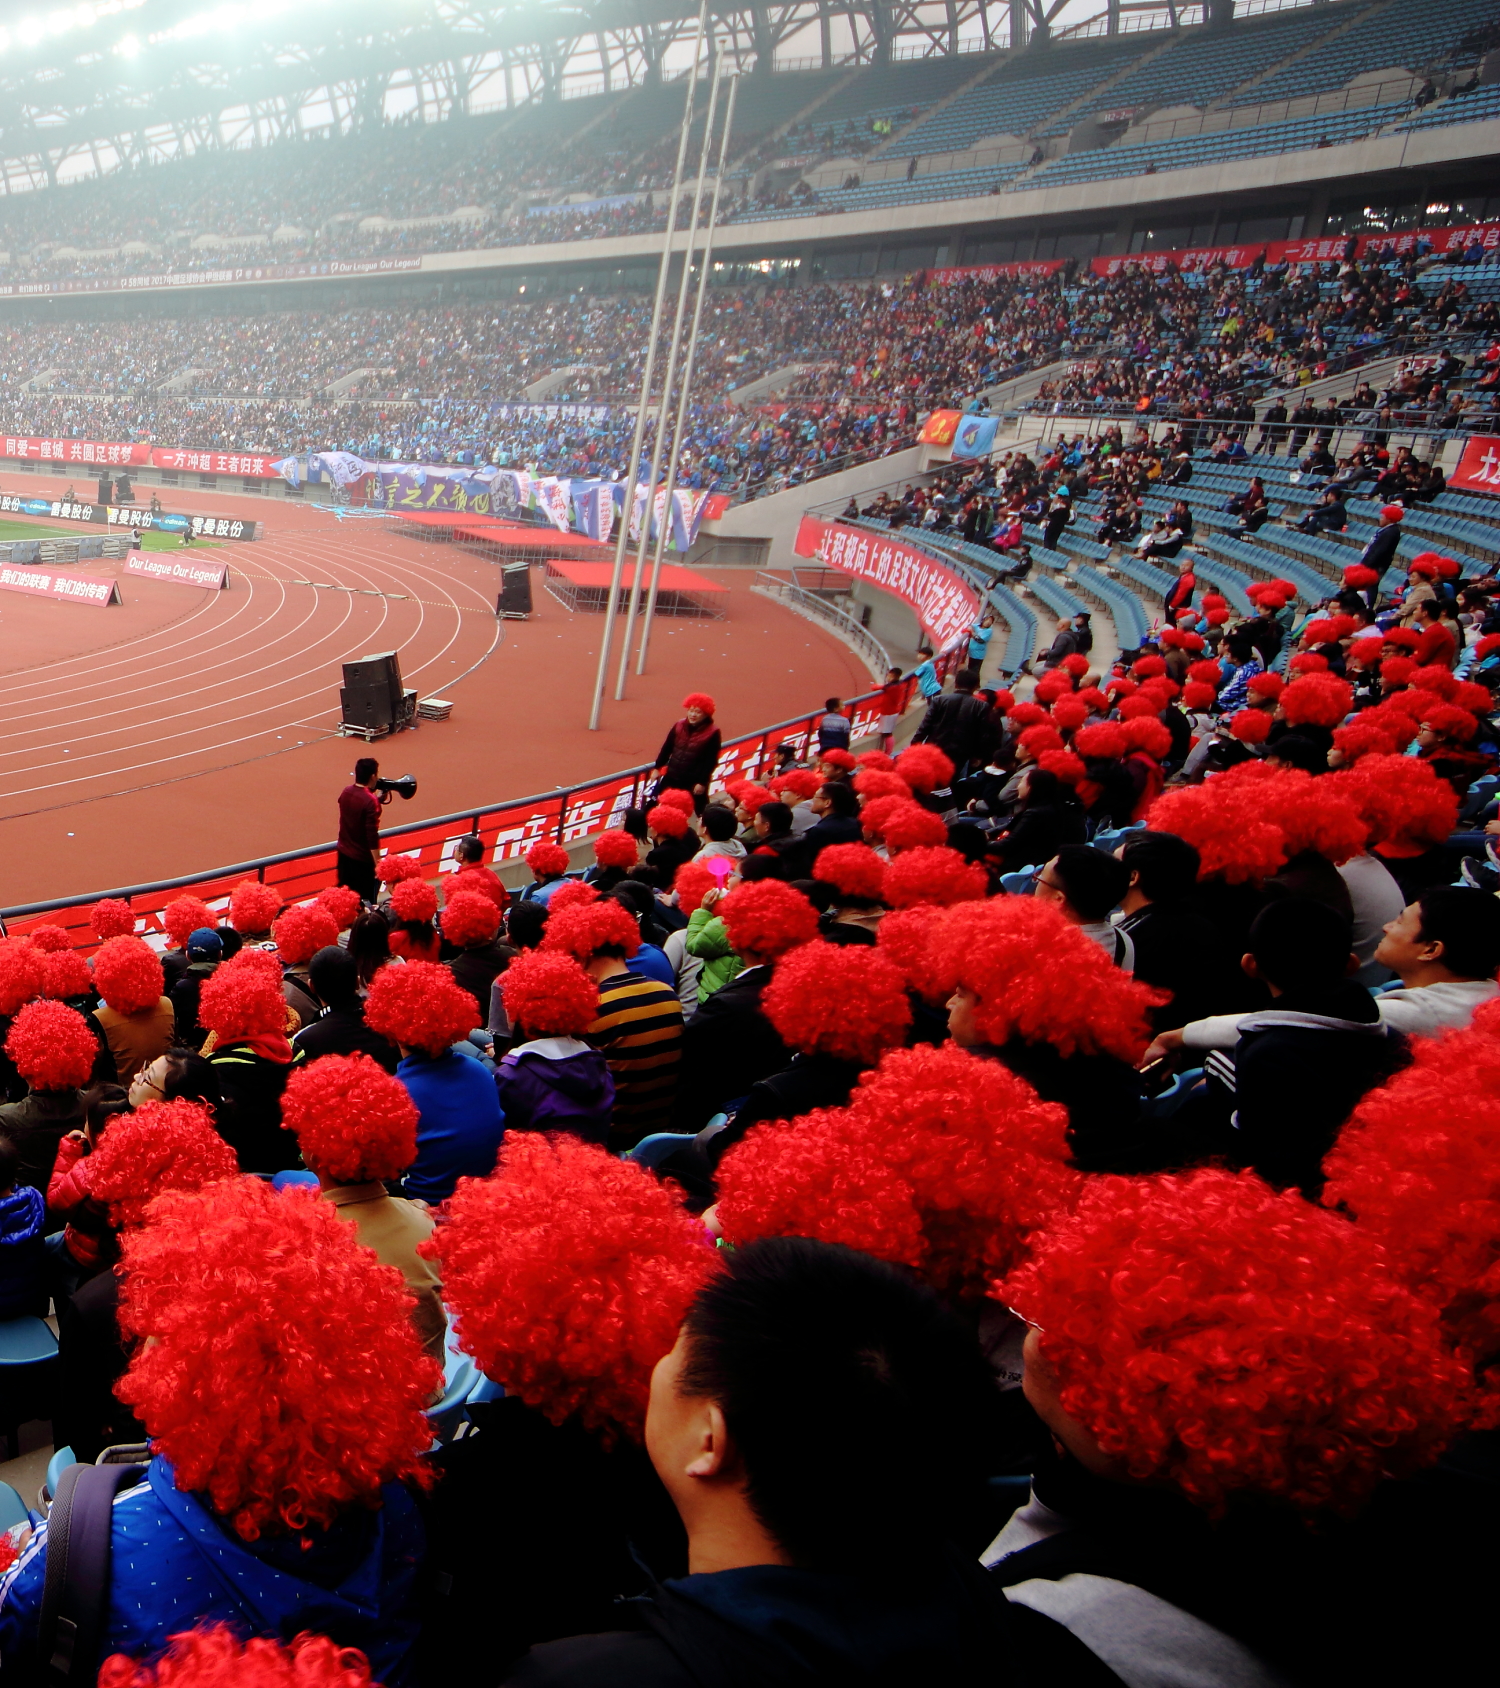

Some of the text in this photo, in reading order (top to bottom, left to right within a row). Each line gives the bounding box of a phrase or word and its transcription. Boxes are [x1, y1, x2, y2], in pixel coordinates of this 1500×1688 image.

[6, 438, 133, 464] 同爱一座城 共圆足球梦
[163, 451, 264, 475] 一方冲超 王者归来
[50, 501, 93, 521] 雷曼股份
[107, 506, 154, 528] 雷曼股份
[192, 516, 245, 539] 雷曼股份
[129, 557, 222, 583] Our League Our Legend
[0, 569, 109, 601] 我们的联赛 我们的传奇
